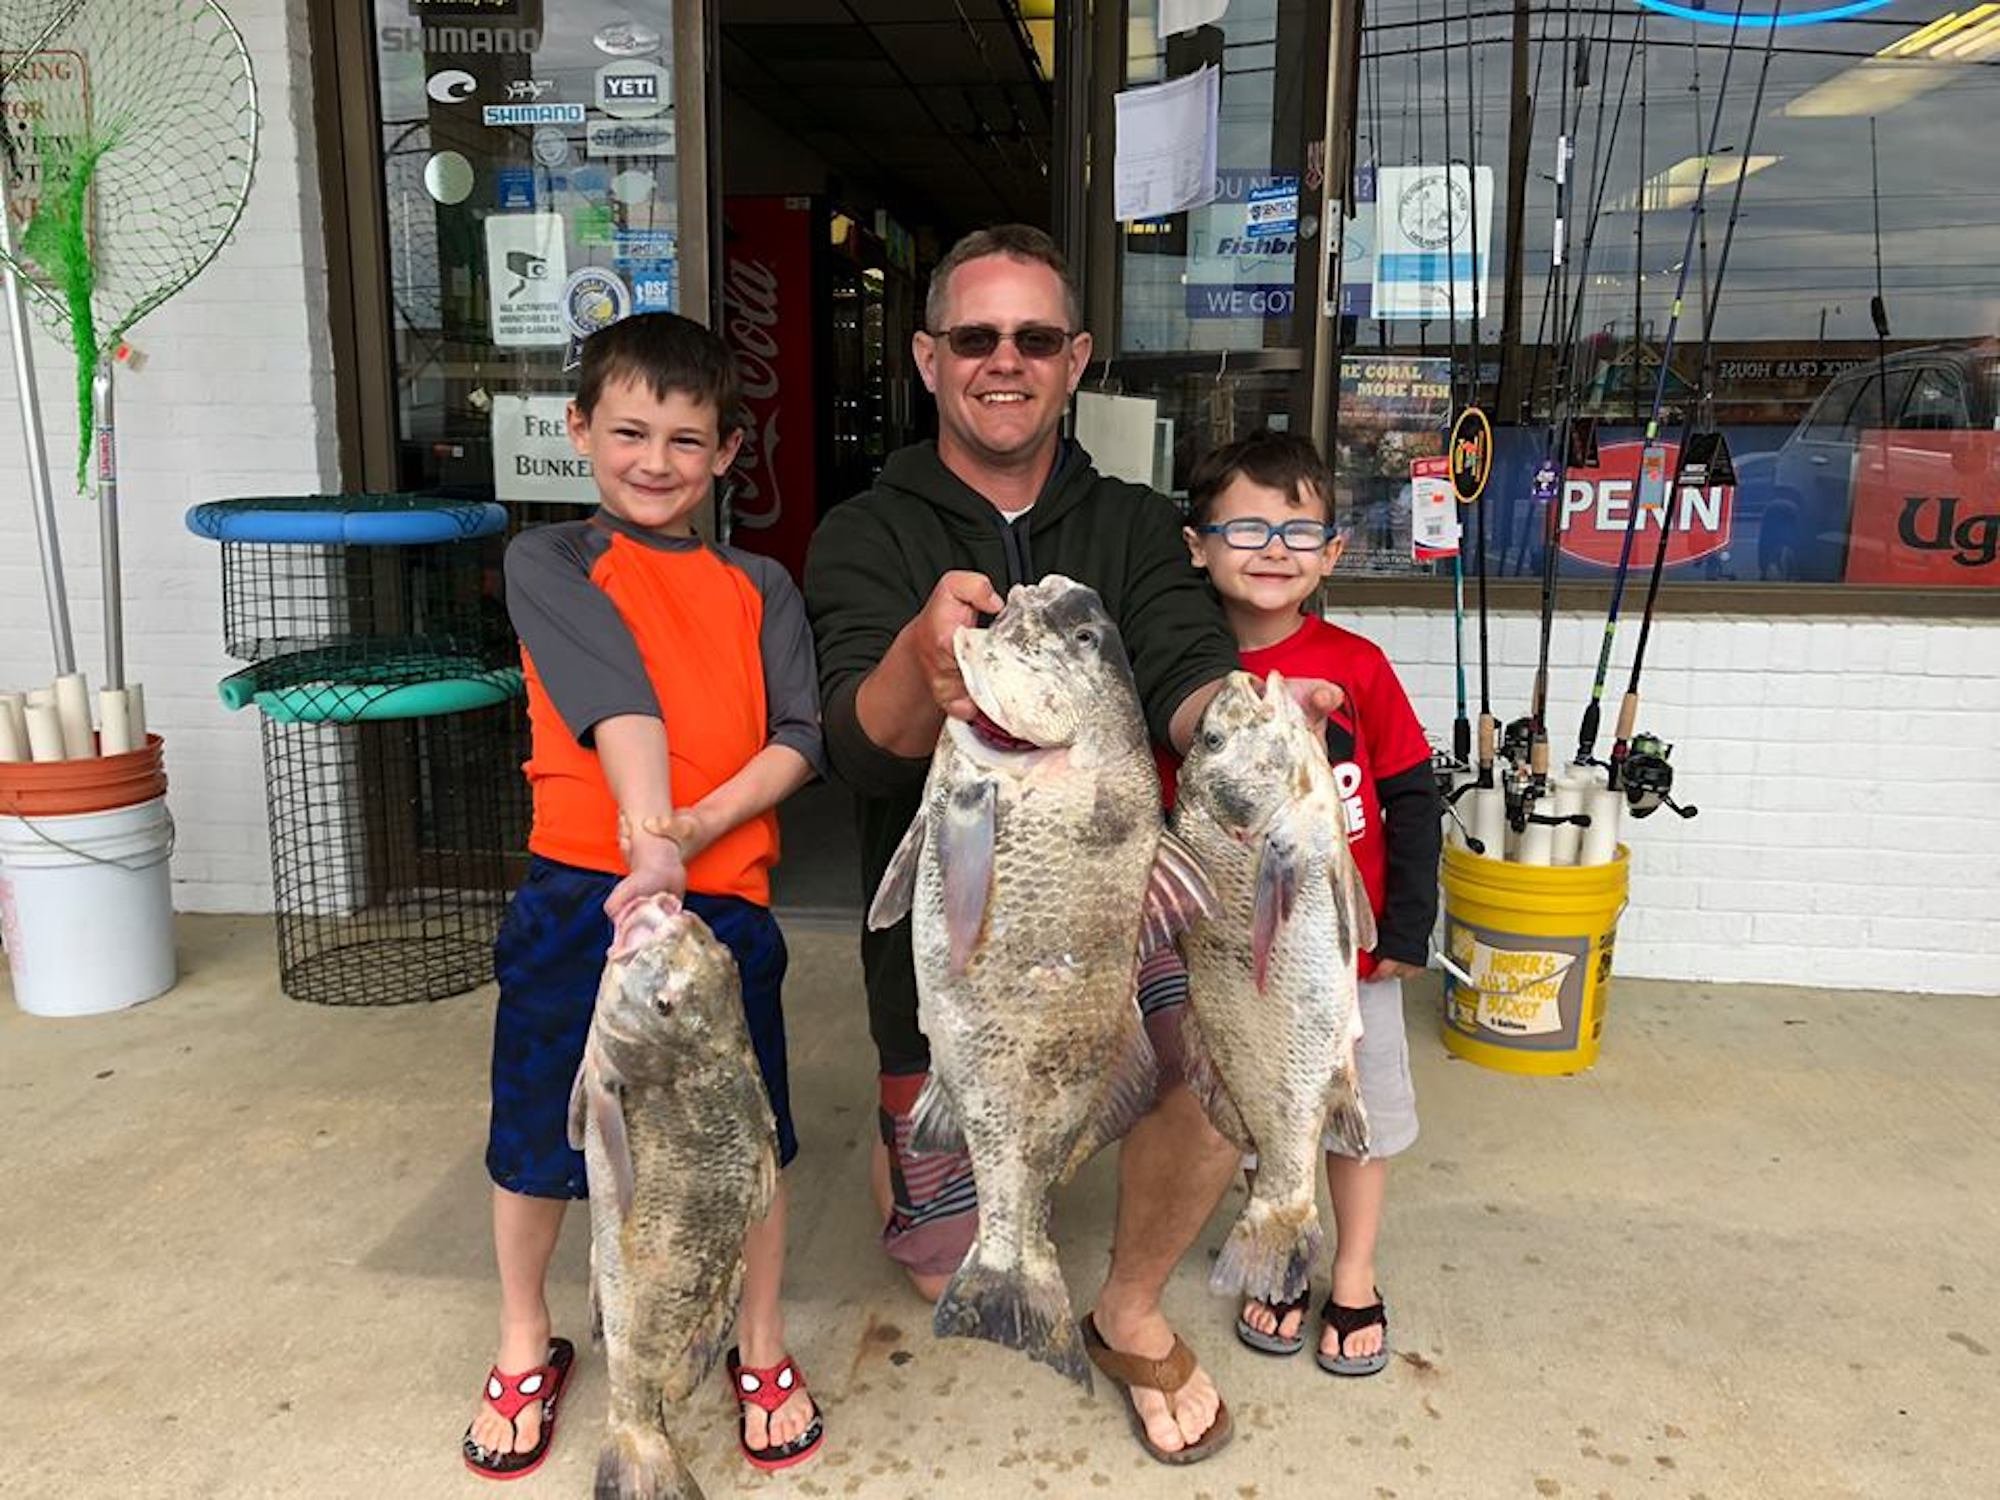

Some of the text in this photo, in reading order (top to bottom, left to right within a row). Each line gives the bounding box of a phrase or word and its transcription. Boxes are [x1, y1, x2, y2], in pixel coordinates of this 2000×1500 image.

[381, 27, 540, 53] SHIMANO
[606, 78, 654, 95] YETI
[486, 106, 583, 122] SHIMANO
[1208, 291, 1244, 312] WE
[1365, 365, 1422, 380] CORAL
[1357, 381, 1450, 399] MORE FISH
[525, 415, 566, 436] FRE
[515, 454, 594, 477] BUNKE
[1559, 480, 1722, 531] PENN
